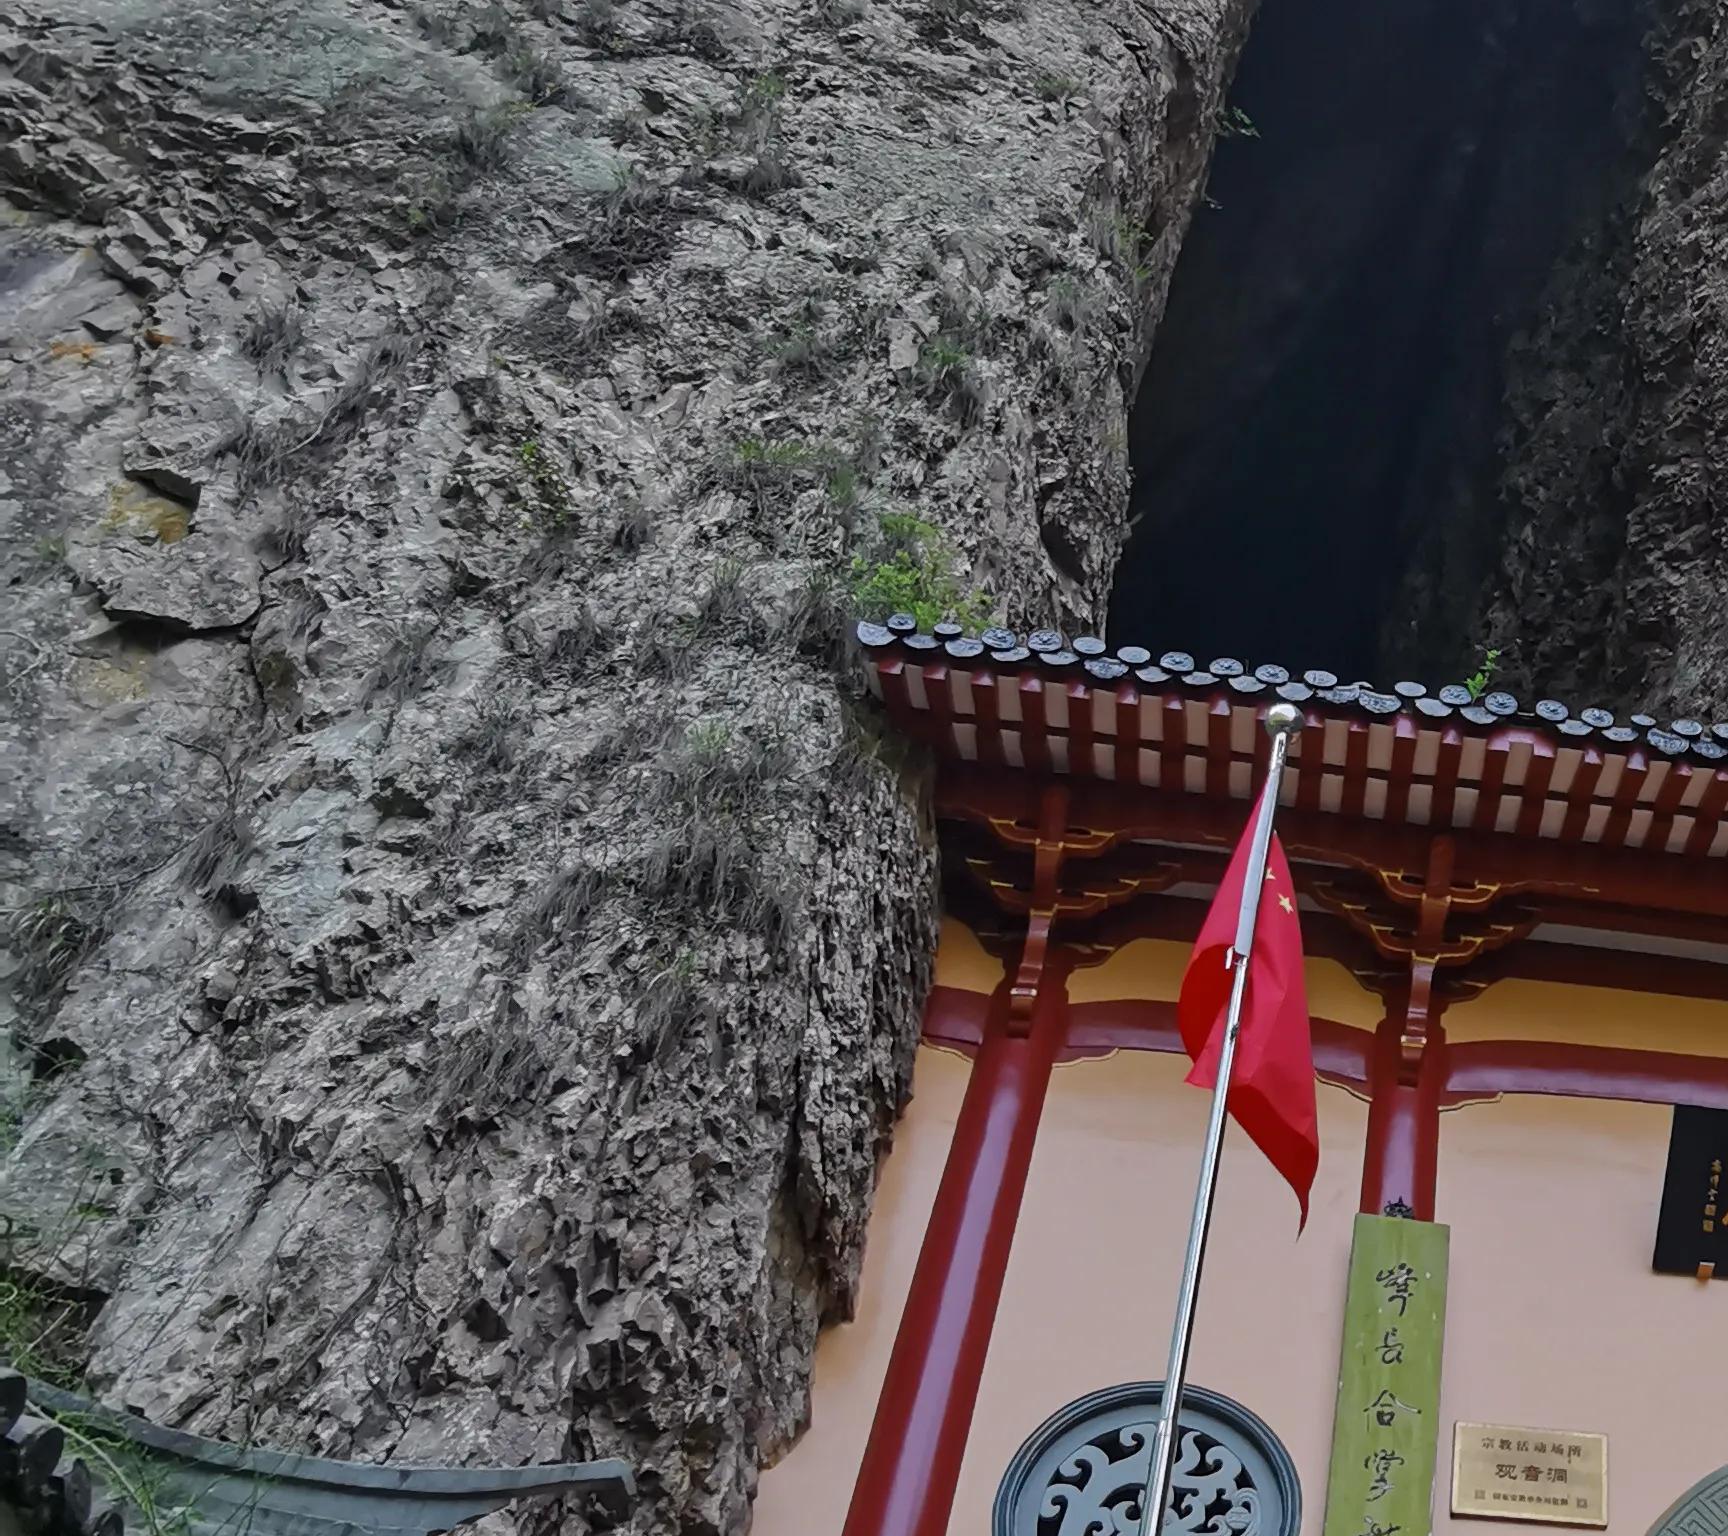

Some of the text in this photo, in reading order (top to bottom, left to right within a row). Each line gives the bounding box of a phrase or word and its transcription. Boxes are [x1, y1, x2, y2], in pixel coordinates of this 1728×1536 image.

[1481, 1436, 1583, 1460] 宗教活动场所
[1495, 1463, 1568, 1484] 观音洞
